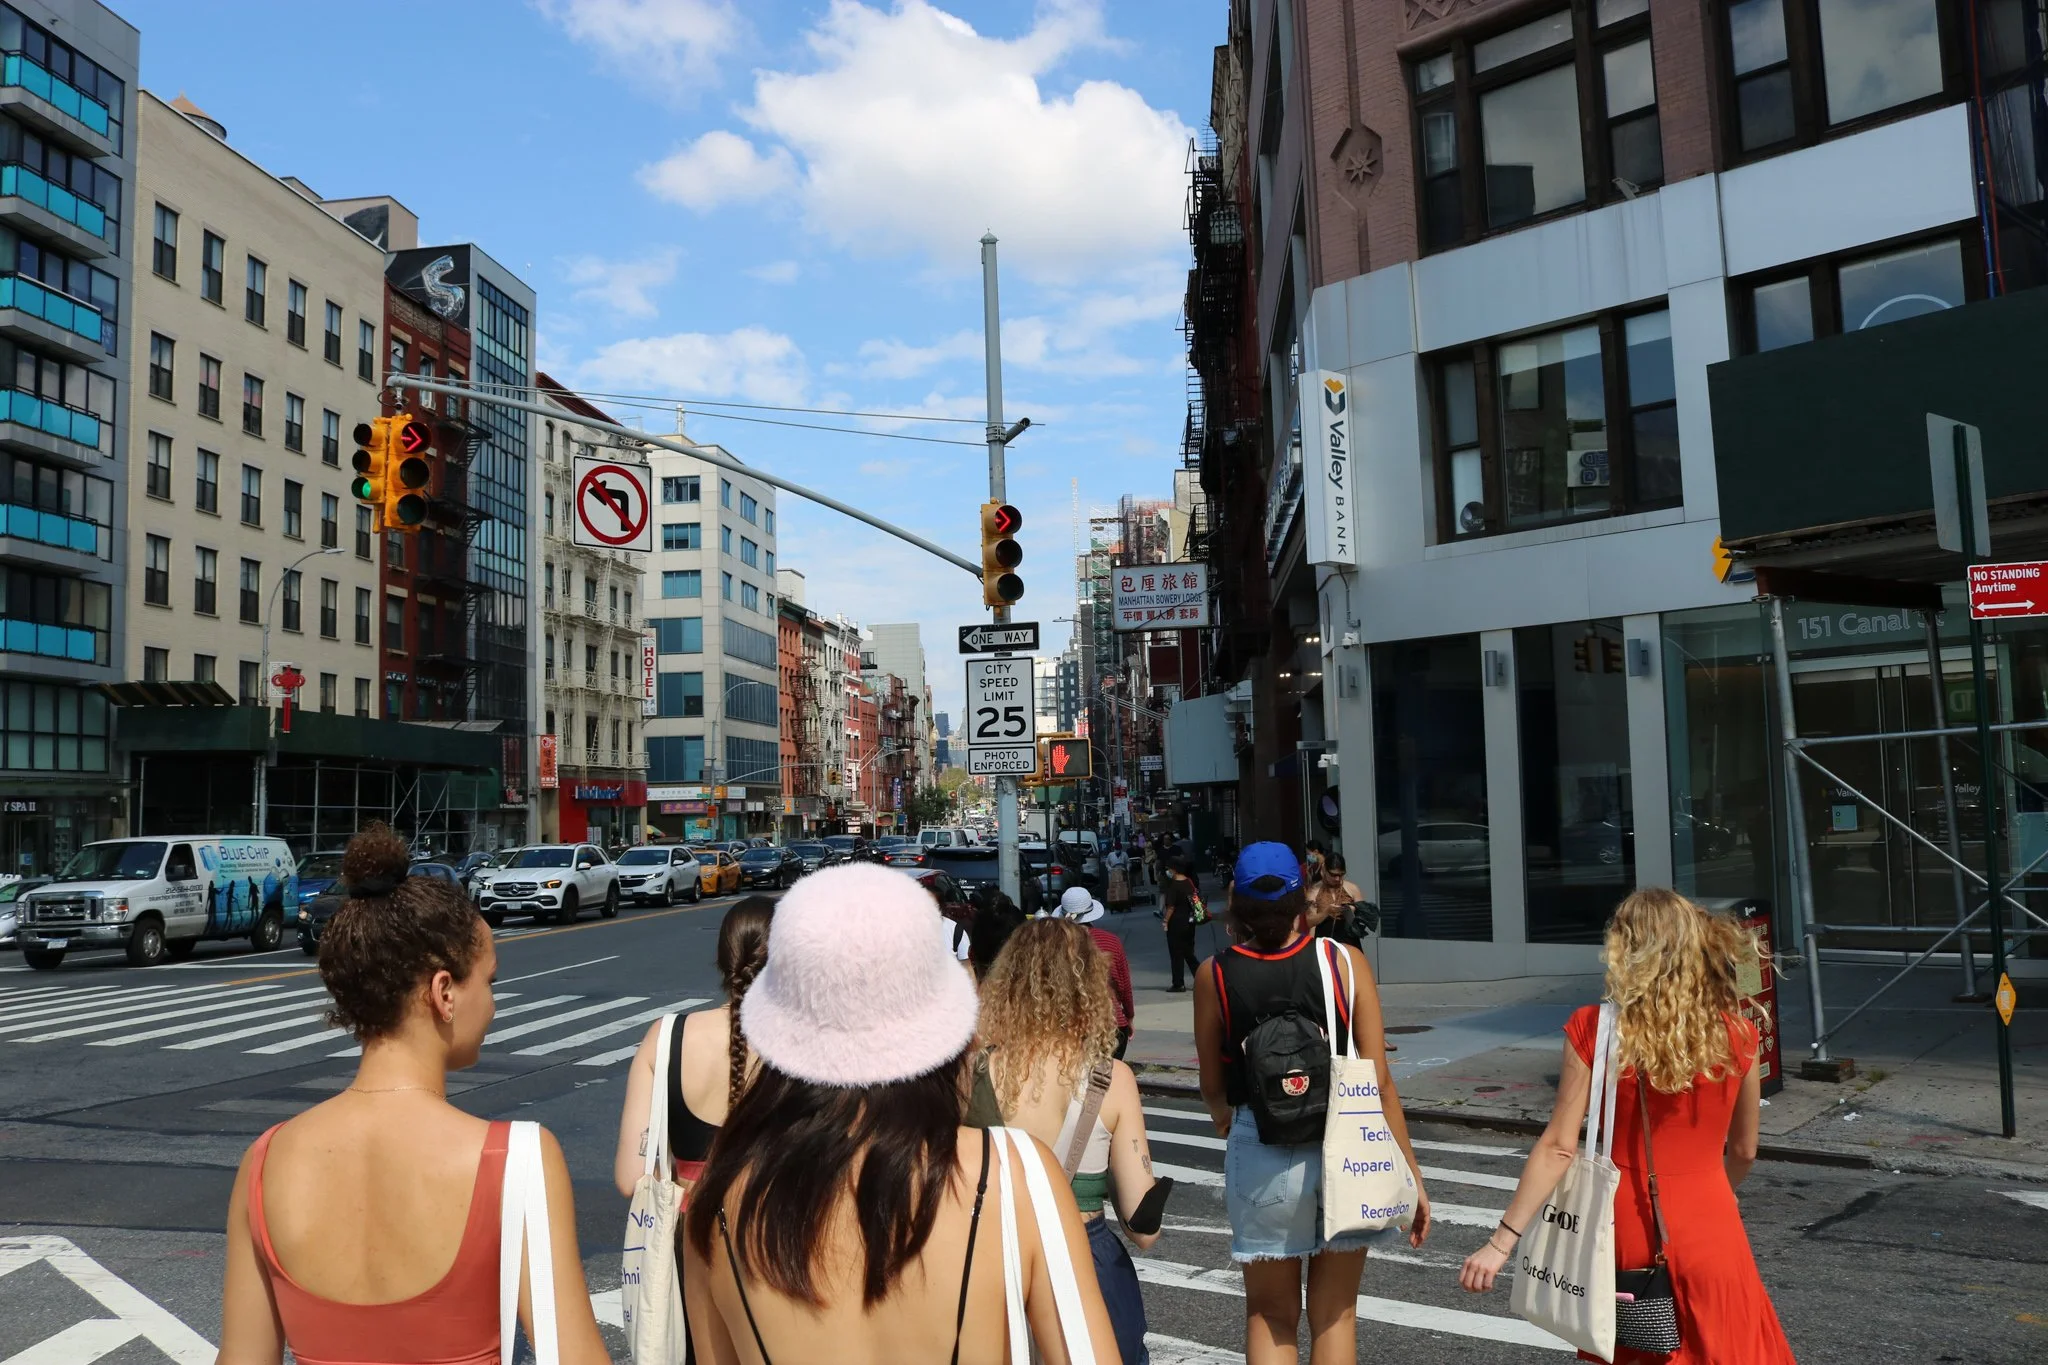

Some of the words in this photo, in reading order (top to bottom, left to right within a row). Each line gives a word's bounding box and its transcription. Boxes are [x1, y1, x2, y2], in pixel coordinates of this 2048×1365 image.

[1328, 420, 1347, 490] Valley
[1335, 496, 1347, 557] BANK
[1973, 571, 1988, 581] NO
[1990, 568, 2041, 580] STANDING
[1121, 572, 1198, 593] 包厘旅館
[1975, 582, 2017, 595] Anytime
[1118, 595, 1155, 606] MANHATTAN
[1156, 594, 1181, 604] BOWERY
[1182, 593, 1203, 603] LODGE
[1798, 615, 1831, 640] 151
[1838, 608, 1911, 636] Canal
[971, 633, 994, 645] ONE
[1004, 631, 1029, 643] WAY
[644, 647, 655, 698] HOTEL
[985, 664, 1012, 675] CITY
[979, 677, 1019, 688] SPEED
[984, 691, 1015, 702] LIMIT
[976, 705, 1027, 738] 25
[984, 751, 1019, 760] PHOTO
[974, 761, 1030, 771] ENFORCED
[11, 801, 27, 812] SPA
[219, 846, 244, 861] BLUE
[246, 845, 269, 860] CHIP
[1343, 1157, 1395, 1177] Apparel
[1361, 1200, 1410, 1220] Recreation
